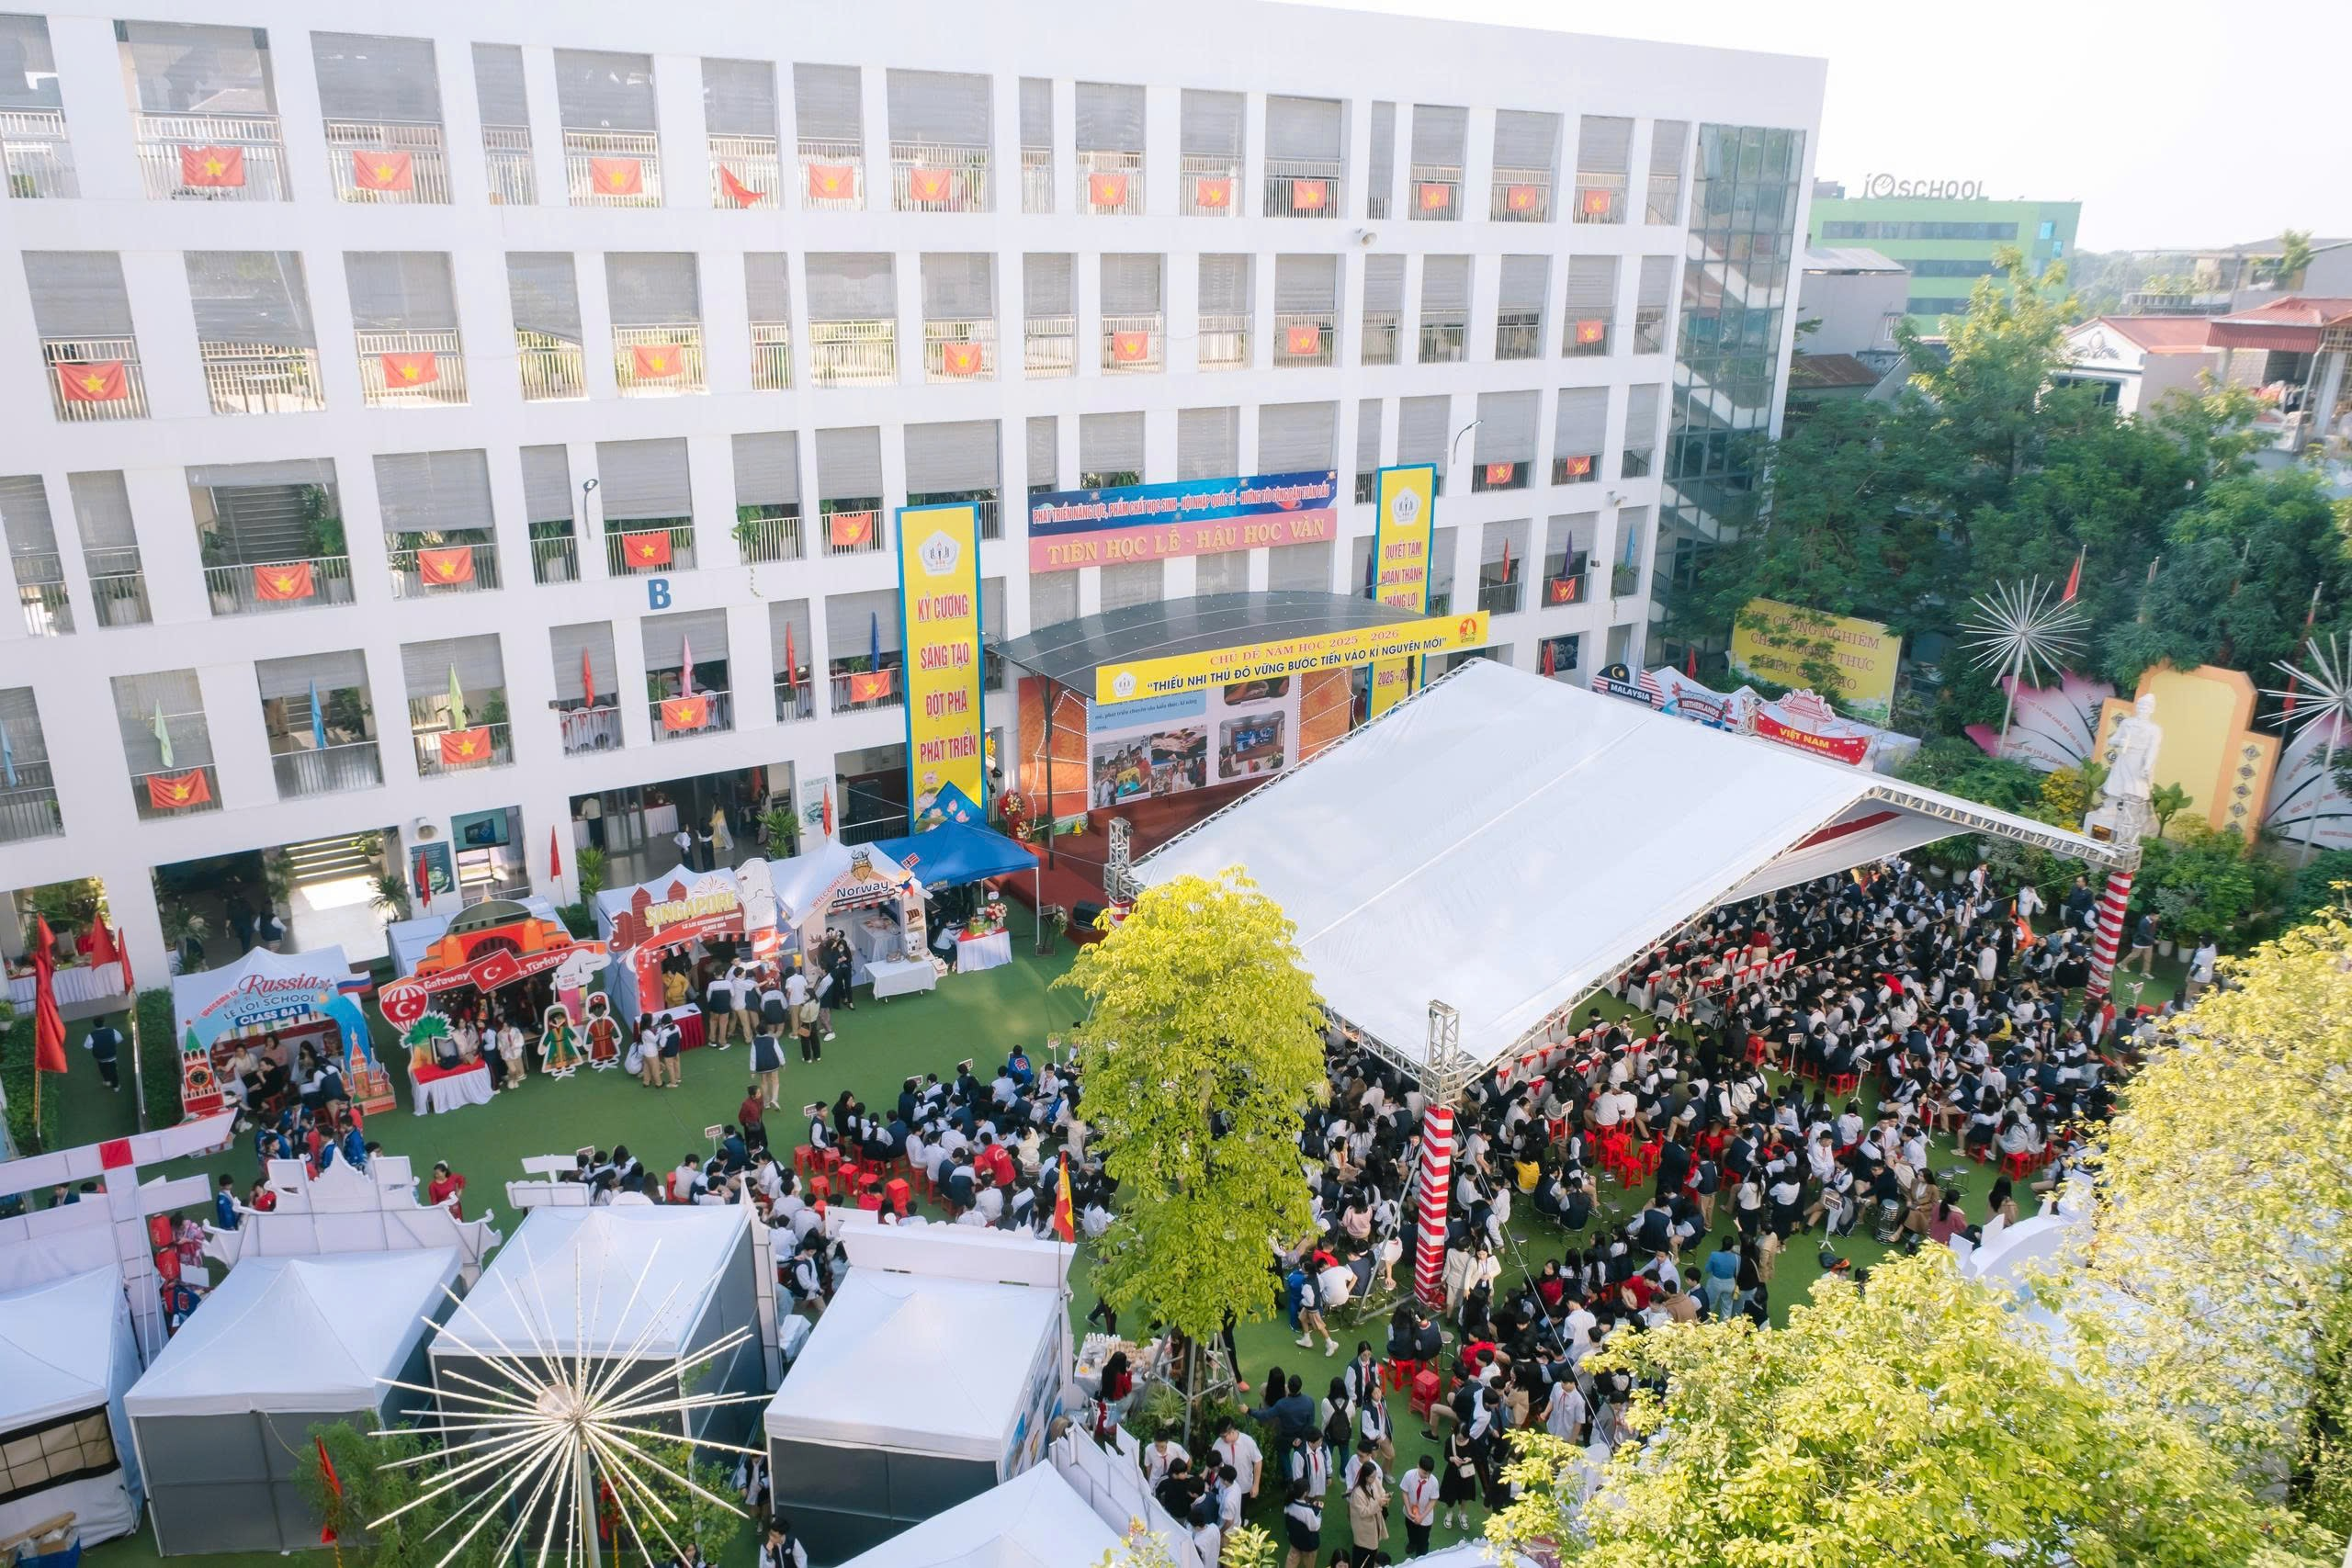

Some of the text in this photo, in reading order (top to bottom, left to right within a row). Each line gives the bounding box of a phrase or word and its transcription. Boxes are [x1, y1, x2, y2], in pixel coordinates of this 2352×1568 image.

[1033, 504, 1051, 525] PHÁT
[1052, 501, 1072, 523] TRIỂN
[1073, 502, 1093, 521] NĂNG
[1093, 502, 1109, 522] LỰC,
[1109, 497, 1129, 516] PHẨM
[1129, 495, 1148, 514] CHẤT
[1148, 500, 1161, 516] HỌC
[1161, 497, 1177, 512] SINH
[1181, 493, 1193, 511] HỘI
[1193, 491, 1211, 511] NHẬP
[1211, 489, 1228, 508] QUỐC
[1228, 488, 1237, 505] TẾ
[1240, 487, 1261, 503] HƯỚNG
[1272, 485, 1288, 502] CÔNG
[1047, 538, 1098, 565] TIÊN
[1105, 536, 1148, 563] HỌC
[1154, 526, 1182, 554] LỄ
[1196, 525, 1237, 550] HẬU
[1243, 523, 1283, 546] HỌC
[1289, 515, 1325, 538] VĂN
[1385, 539, 1422, 562] QUYẾT TÂM
[1381, 564, 1423, 585] HOÀN THÀNH
[647, 579, 672, 610] B
[933, 592, 970, 619] CƯƠNG
[1385, 590, 1407, 608] THẮNG
[920, 640, 970, 672] SÁNG TẠO
[1210, 650, 1238, 666] CHỦ
[1242, 647, 1261, 661] ĐỀ
[1265, 643, 1294, 659] NĂM
[1298, 637, 1324, 654] HỌC
[1329, 634, 1358, 649] 2025
[1370, 630, 1399, 642] 2026
[1187, 676, 1206, 687] NHI
[1210, 667, 1230, 683] THỦ
[1234, 666, 1250, 680] ĐÔ
[1254, 661, 1284, 676] VỮNG
[1288, 655, 1317, 671] BƯỚC
[1320, 649, 1341, 666] TIẾN
[1344, 646, 1366, 662] VÀO
[1382, 640, 1420, 657] NGUYÊN
[1838, 652, 1875, 673] THỰC
[1378, 671, 1395, 686] 2025
[925, 685, 968, 722] ĐỘT PHÁ
[1611, 683, 1650, 701] MALAYSIA
[1681, 700, 1720, 717] NETHERLANDS
[920, 727, 977, 764] PHÁT TRIỂN
[1780, 728, 1801, 740] VIỆT
[1804, 735, 1829, 748] NAM
[811, 882, 840, 908] WELCOME
[836, 881, 888, 899] Norway
[644, 891, 738, 928] SINGAPORE
[239, 973, 319, 998] Russia
[224, 994, 315, 1021] LE LOI SCHOOL
[240, 1005, 303, 1024] CLASS 8A1
